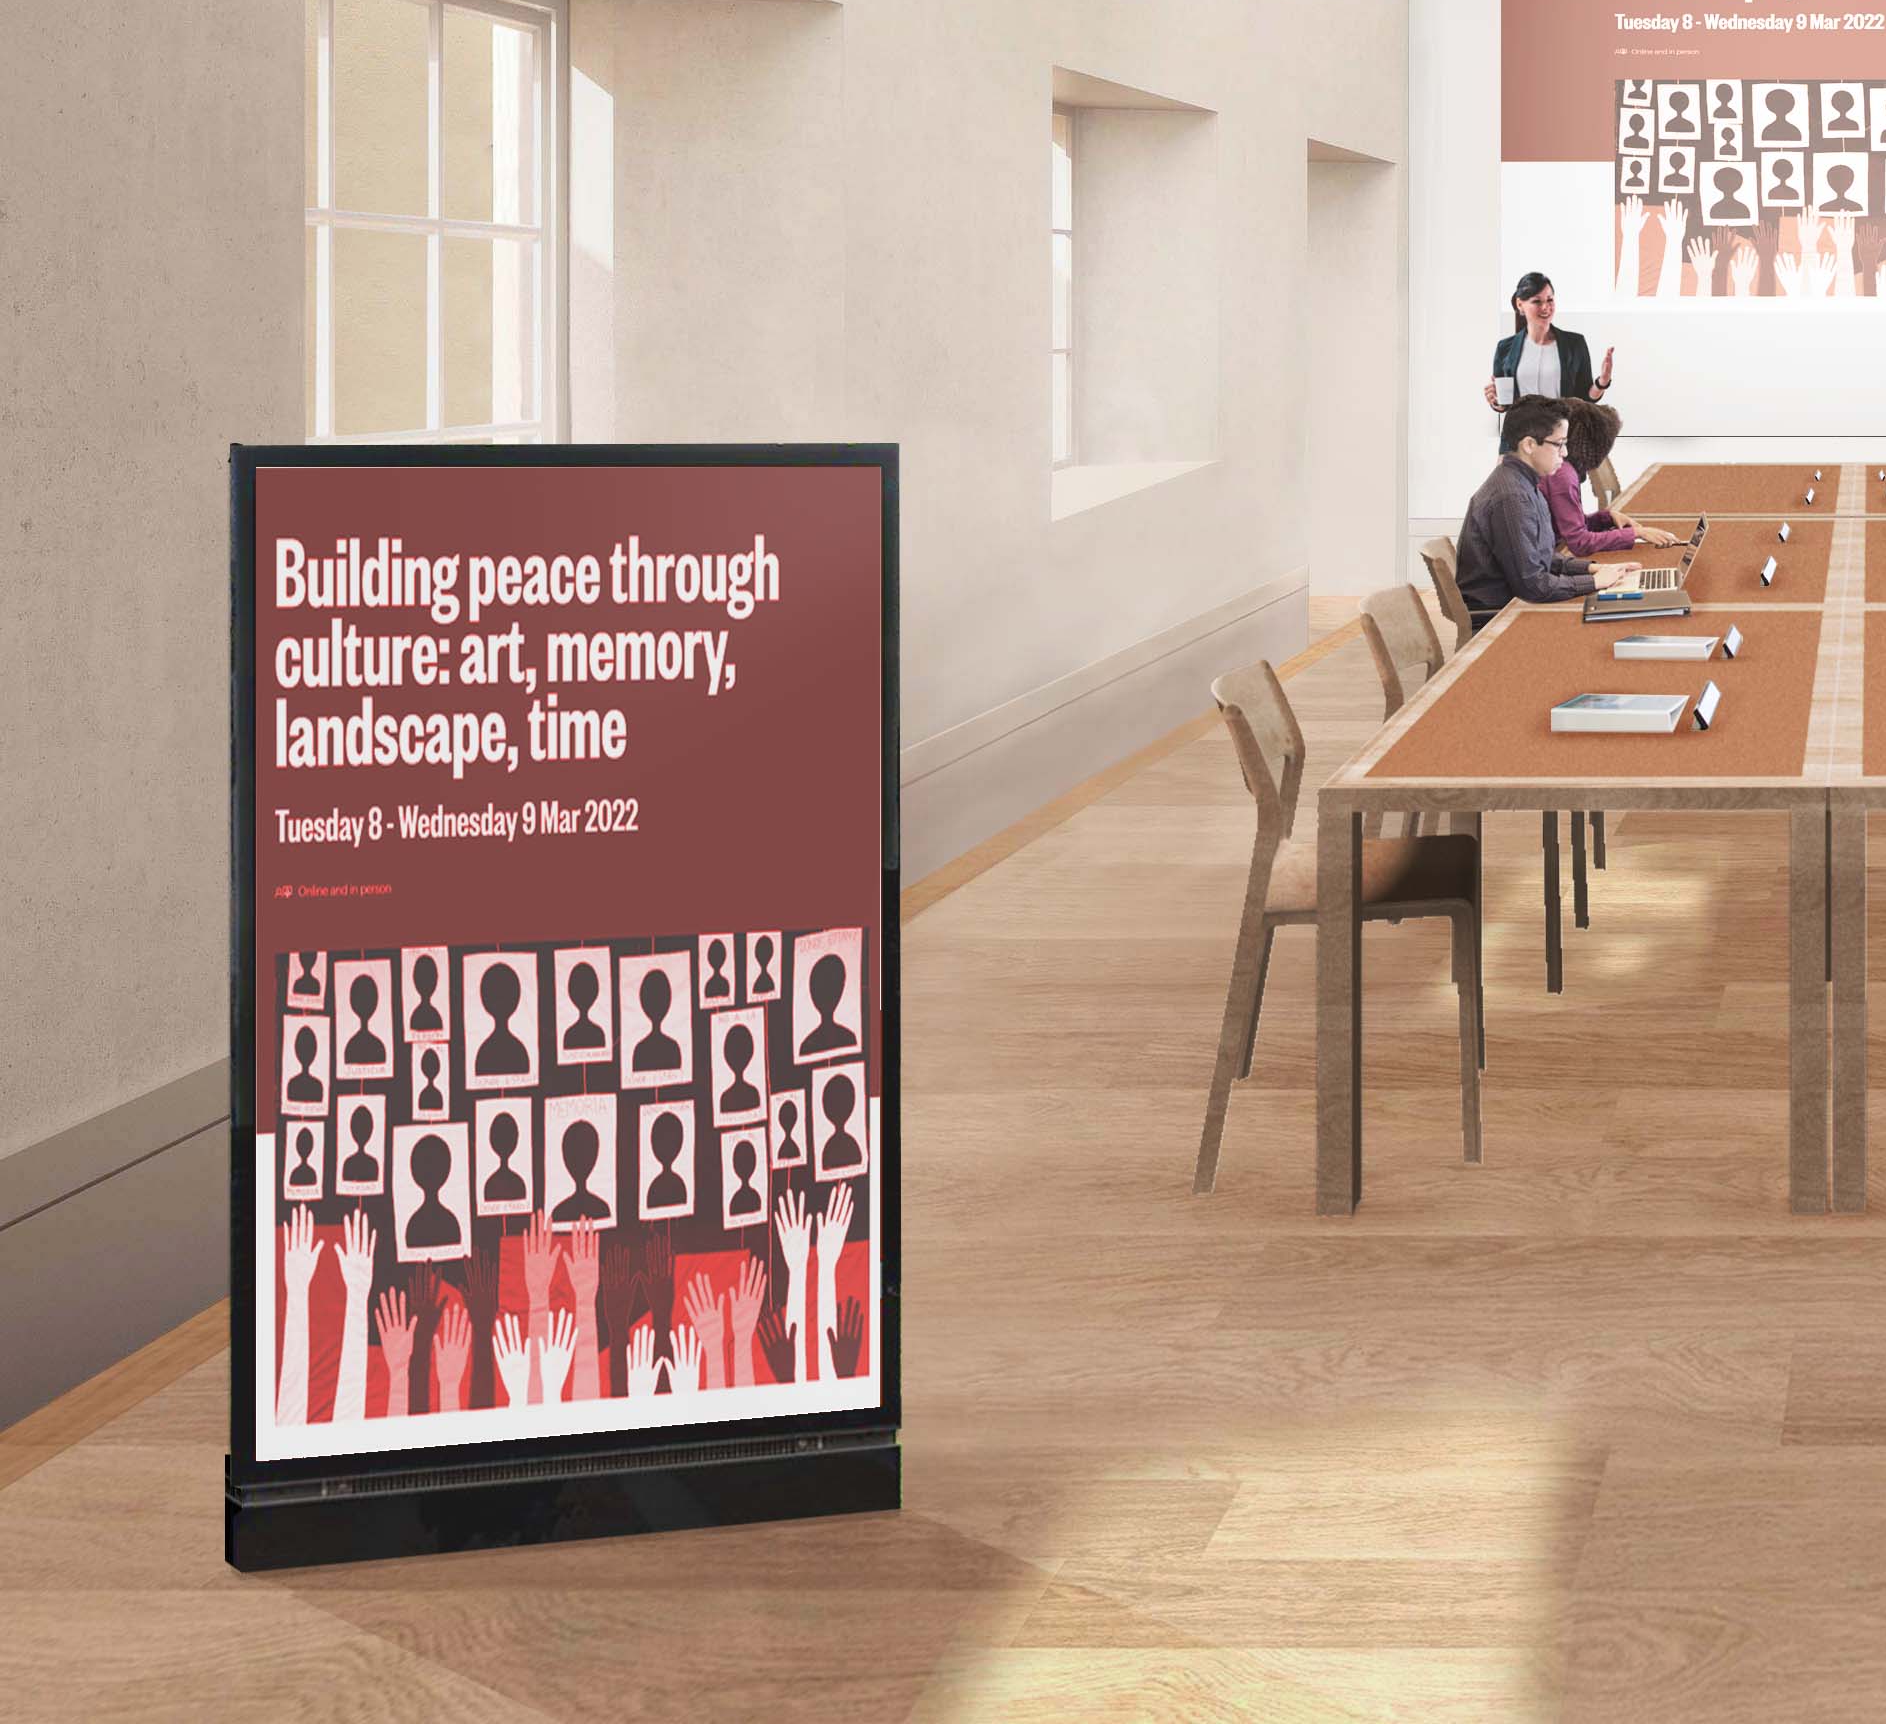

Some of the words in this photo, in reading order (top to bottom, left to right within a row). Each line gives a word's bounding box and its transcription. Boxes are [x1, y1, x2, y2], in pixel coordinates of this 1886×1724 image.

[1614, 13, 1680, 33] Tuesday
[1682, 13, 1693, 30] 8
[1703, 13, 1794, 33] Wednesday
[1795, 13, 1808, 30] 9
[1809, 13, 1841, 30] Mar
[1843, 13, 1885, 30] 2022
[275, 536, 461, 625] Building
[468, 554, 602, 623] peace
[608, 533, 781, 621] through
[274, 616, 451, 689] culture:
[458, 621, 538, 695] art,
[546, 629, 737, 697] memory,
[275, 695, 520, 780] landscape,
[526, 692, 628, 762] time
[274, 807, 366, 849] Tuesday
[367, 805, 384, 841] 8
[397, 802, 518, 843] Wednesday
[521, 800, 537, 836] 9
[539, 799, 582, 835] Mar
[583, 797, 640, 833] 2022
[298, 884, 328, 898] Online
[329, 884, 348, 897] and
[349, 884, 358, 896] in
[360, 883, 392, 898] person
